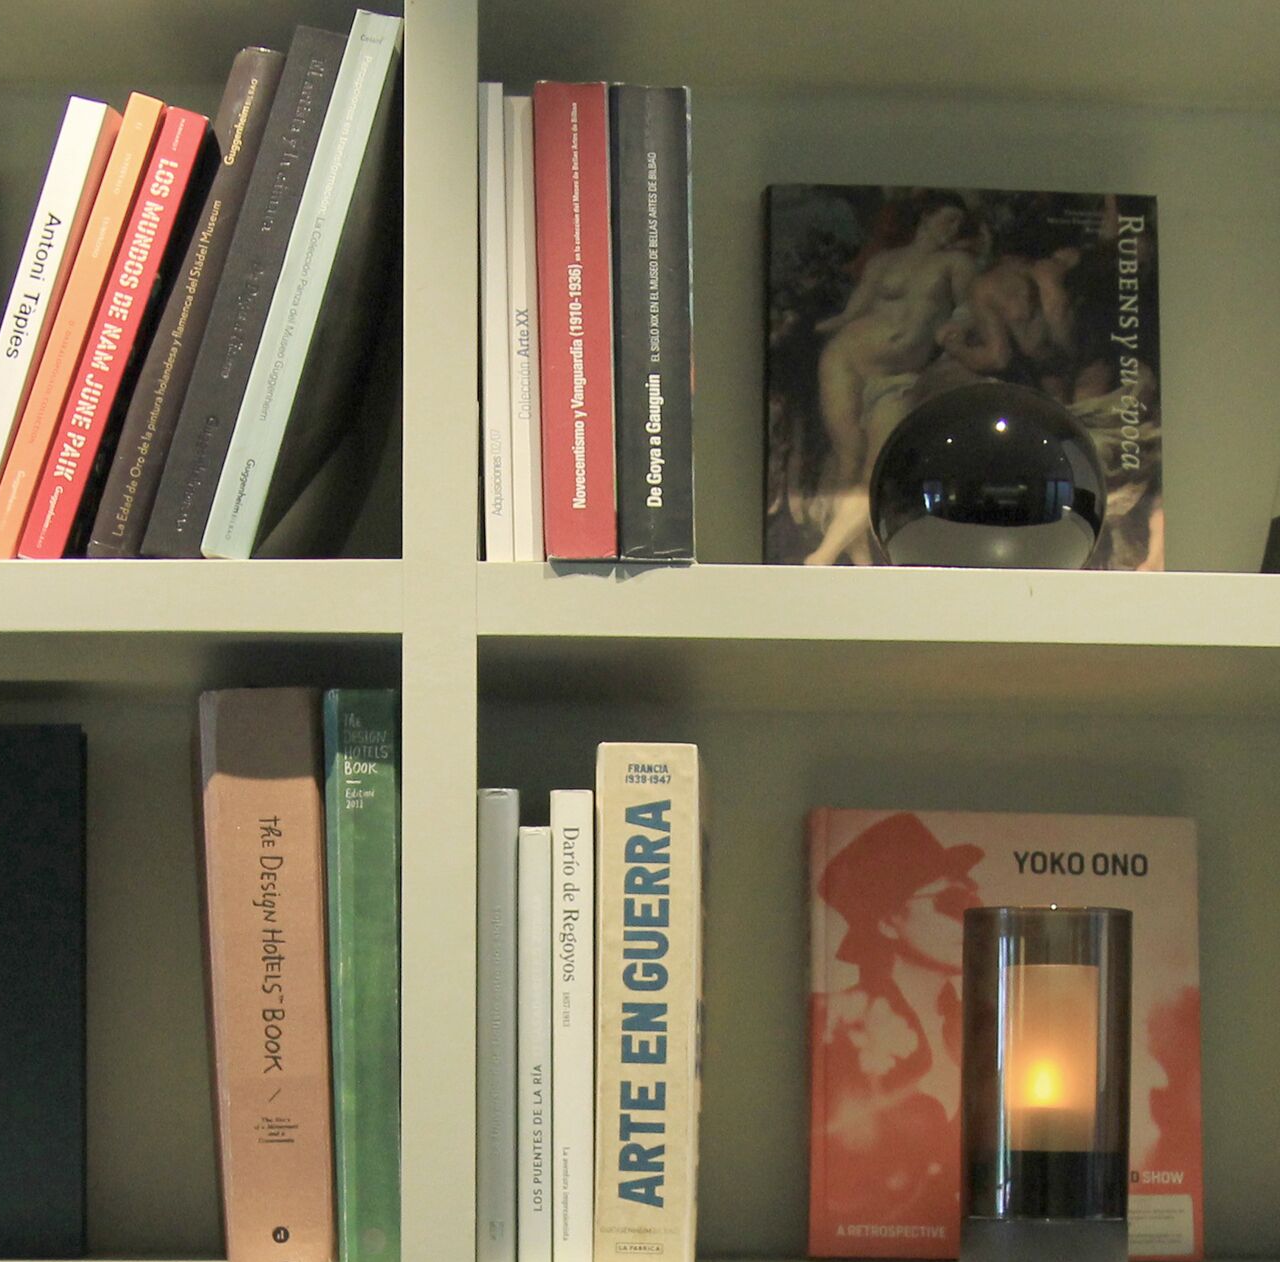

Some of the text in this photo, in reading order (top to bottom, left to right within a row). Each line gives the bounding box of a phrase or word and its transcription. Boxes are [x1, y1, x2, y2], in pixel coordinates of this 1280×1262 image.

[5, 212, 62, 358] Antoni Tàpies
[53, 158, 178, 481] LOS MUNDOS DE NAM JUNE PAIK
[516, 308, 528, 326] XX
[516, 328, 529, 357] Arte
[1110, 331, 1138, 348] y
[568, 263, 587, 508] Novecentismo y Vanguardia (1910-1936)
[1120, 355, 1139, 384] su
[645, 374, 664, 507] De Goya a Gauguin
[1112, 394, 1146, 470] época
[625, 775, 671, 784] 1938-1947
[628, 764, 668, 773] FRANCIA
[1014, 850, 1149, 877] YOKO ONO
[618, 799, 671, 1209] ARTE EN GUERRA
[531, 1064, 542, 1211] LOS PUENTES DE LA RÍA
